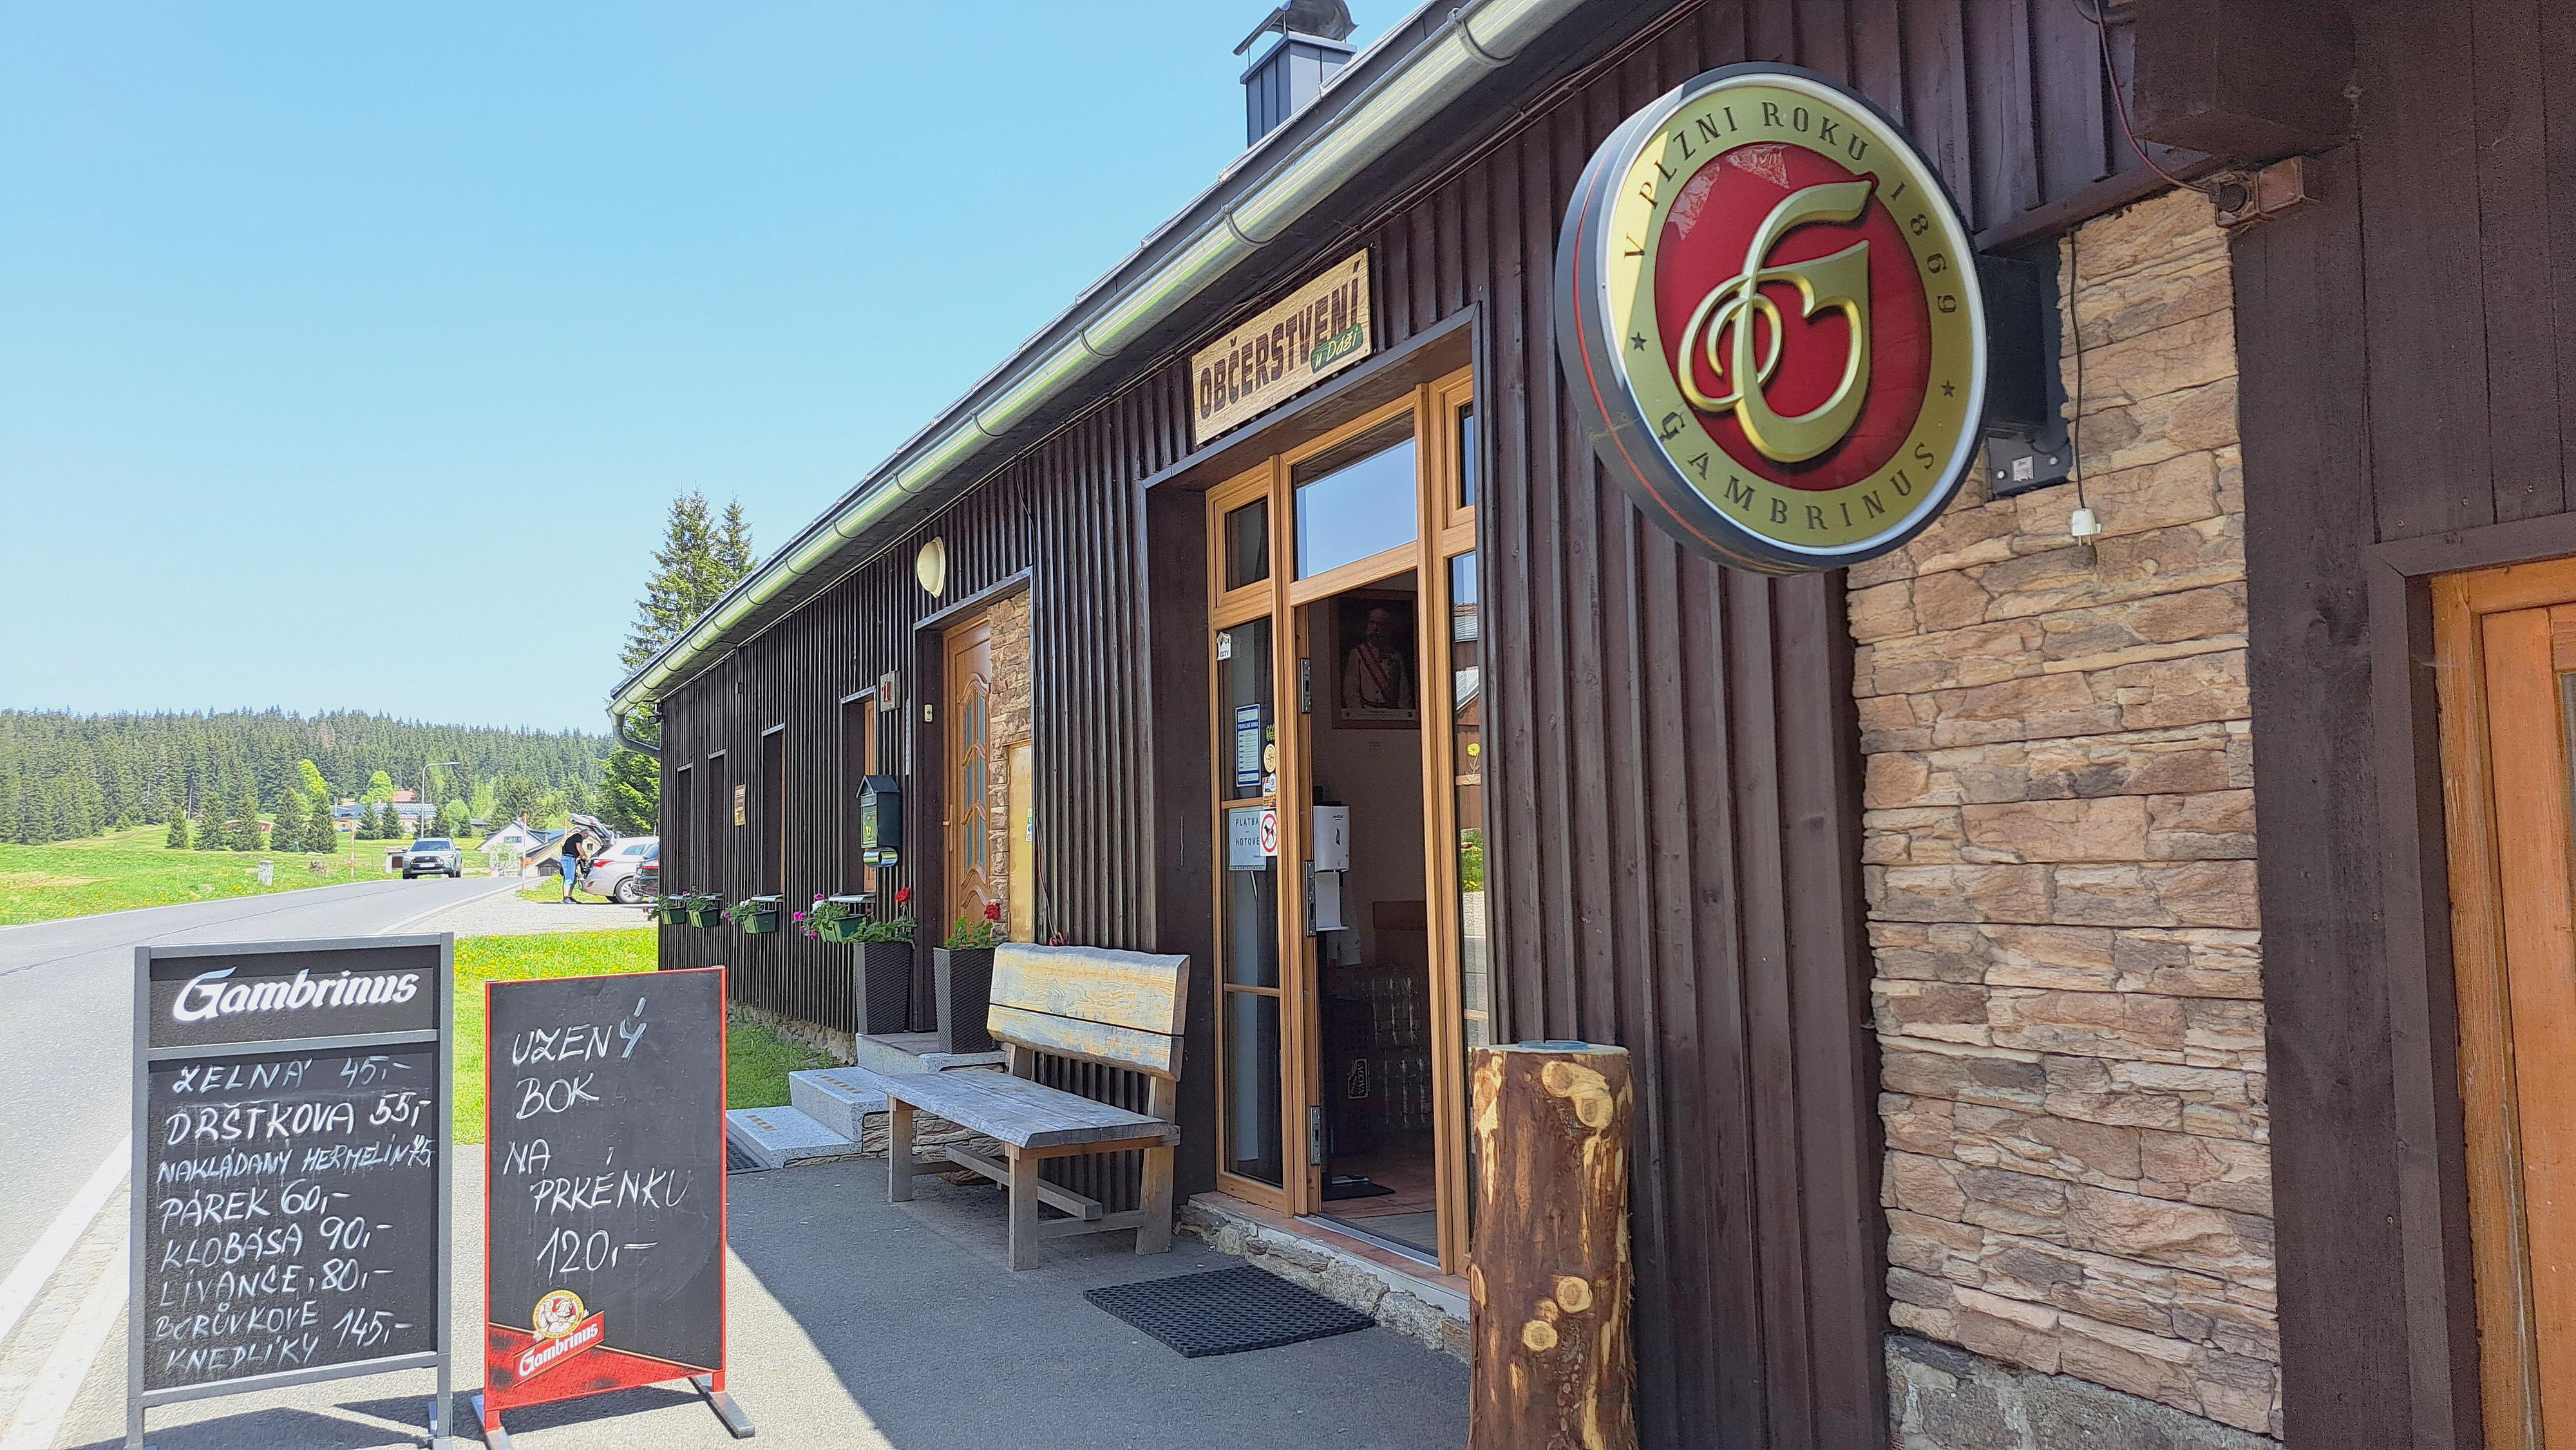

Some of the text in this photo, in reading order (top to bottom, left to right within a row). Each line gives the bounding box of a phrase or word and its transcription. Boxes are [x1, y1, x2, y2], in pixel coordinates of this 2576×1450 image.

[1624, 102, 1957, 314] V PLZNI ROKU 1869
[1200, 260, 1360, 420] OBČERSTVENÍ
[1659, 411, 1935, 531] GAMBRINUS
[1235, 818, 1259, 827] PLATBA
[172, 966, 420, 1022] Gambrinus
[513, 997, 647, 1064] UZENÝ
[516, 1073, 600, 1120] BOK
[503, 1138, 552, 1175] NA
[518, 1321, 600, 1377] Gambrinus
